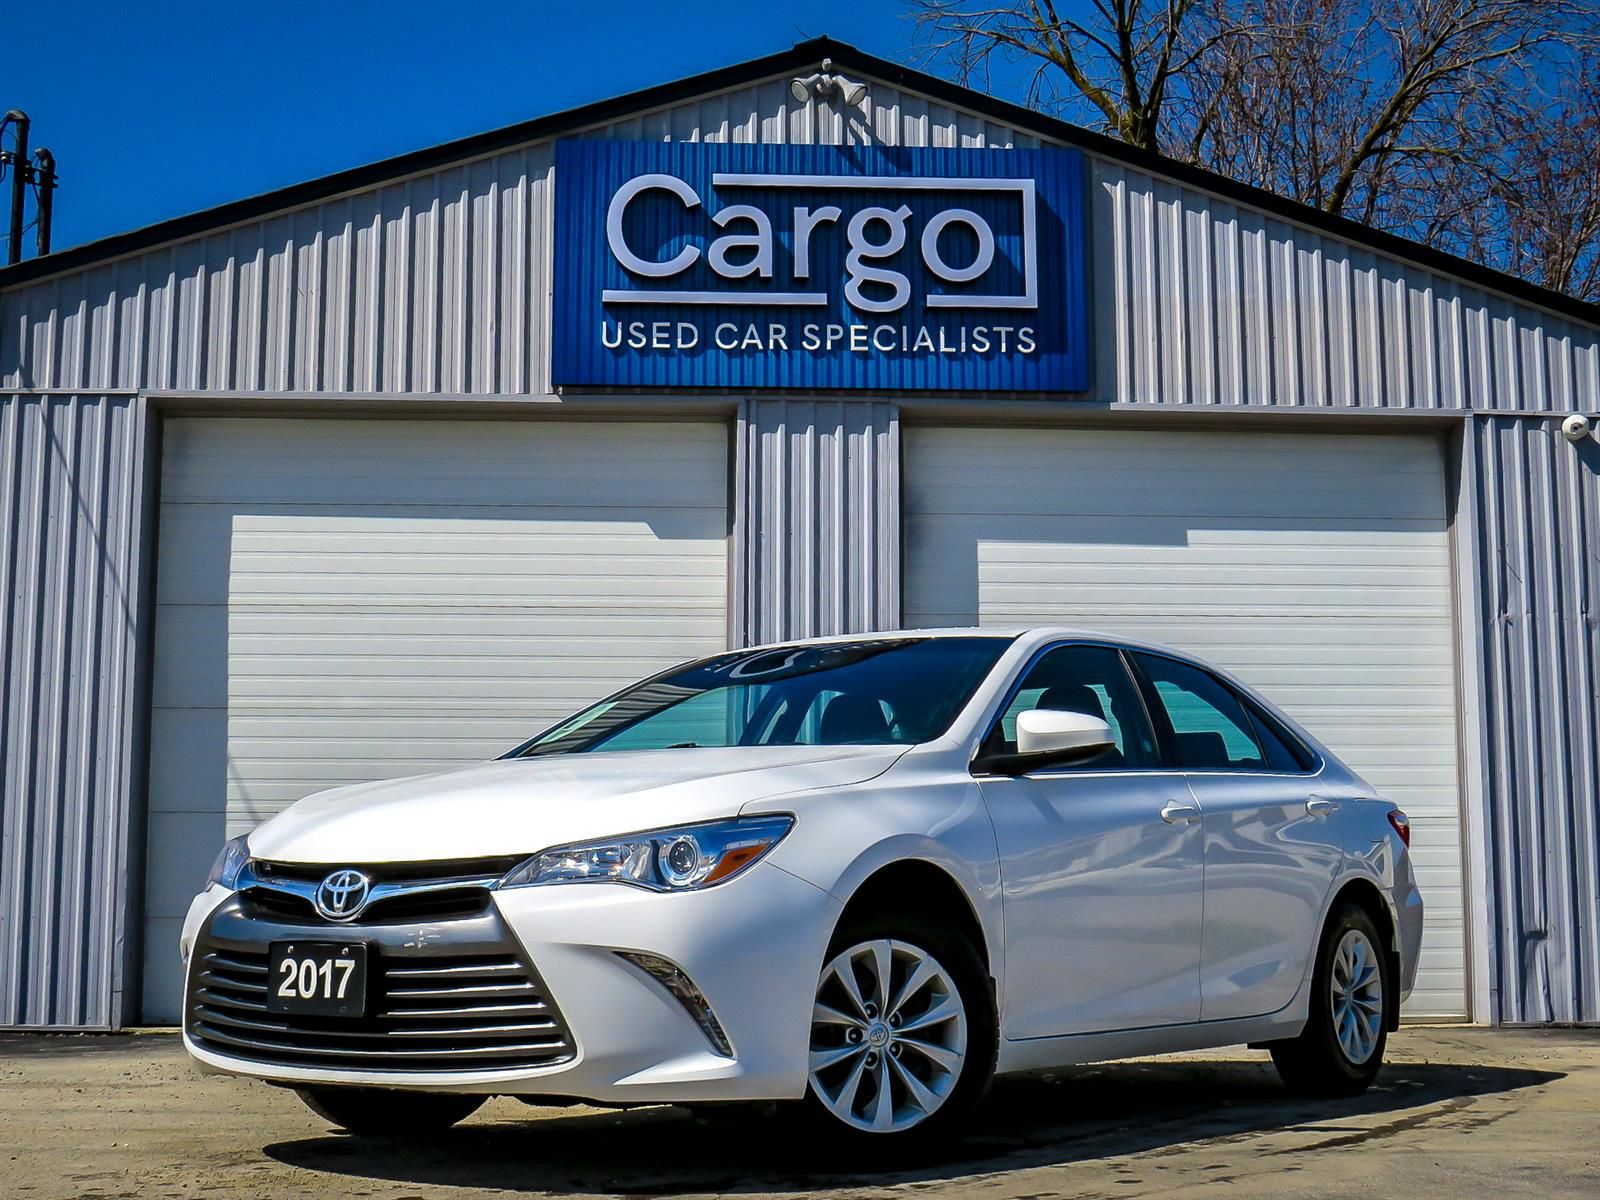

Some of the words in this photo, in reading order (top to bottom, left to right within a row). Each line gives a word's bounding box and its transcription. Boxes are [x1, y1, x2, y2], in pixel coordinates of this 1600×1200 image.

[607, 174, 994, 312] Cargo
[602, 321, 698, 349] USED
[715, 322, 788, 351] CAR
[802, 324, 1037, 354] SPECIALISTS
[278, 958, 356, 999] 2017
